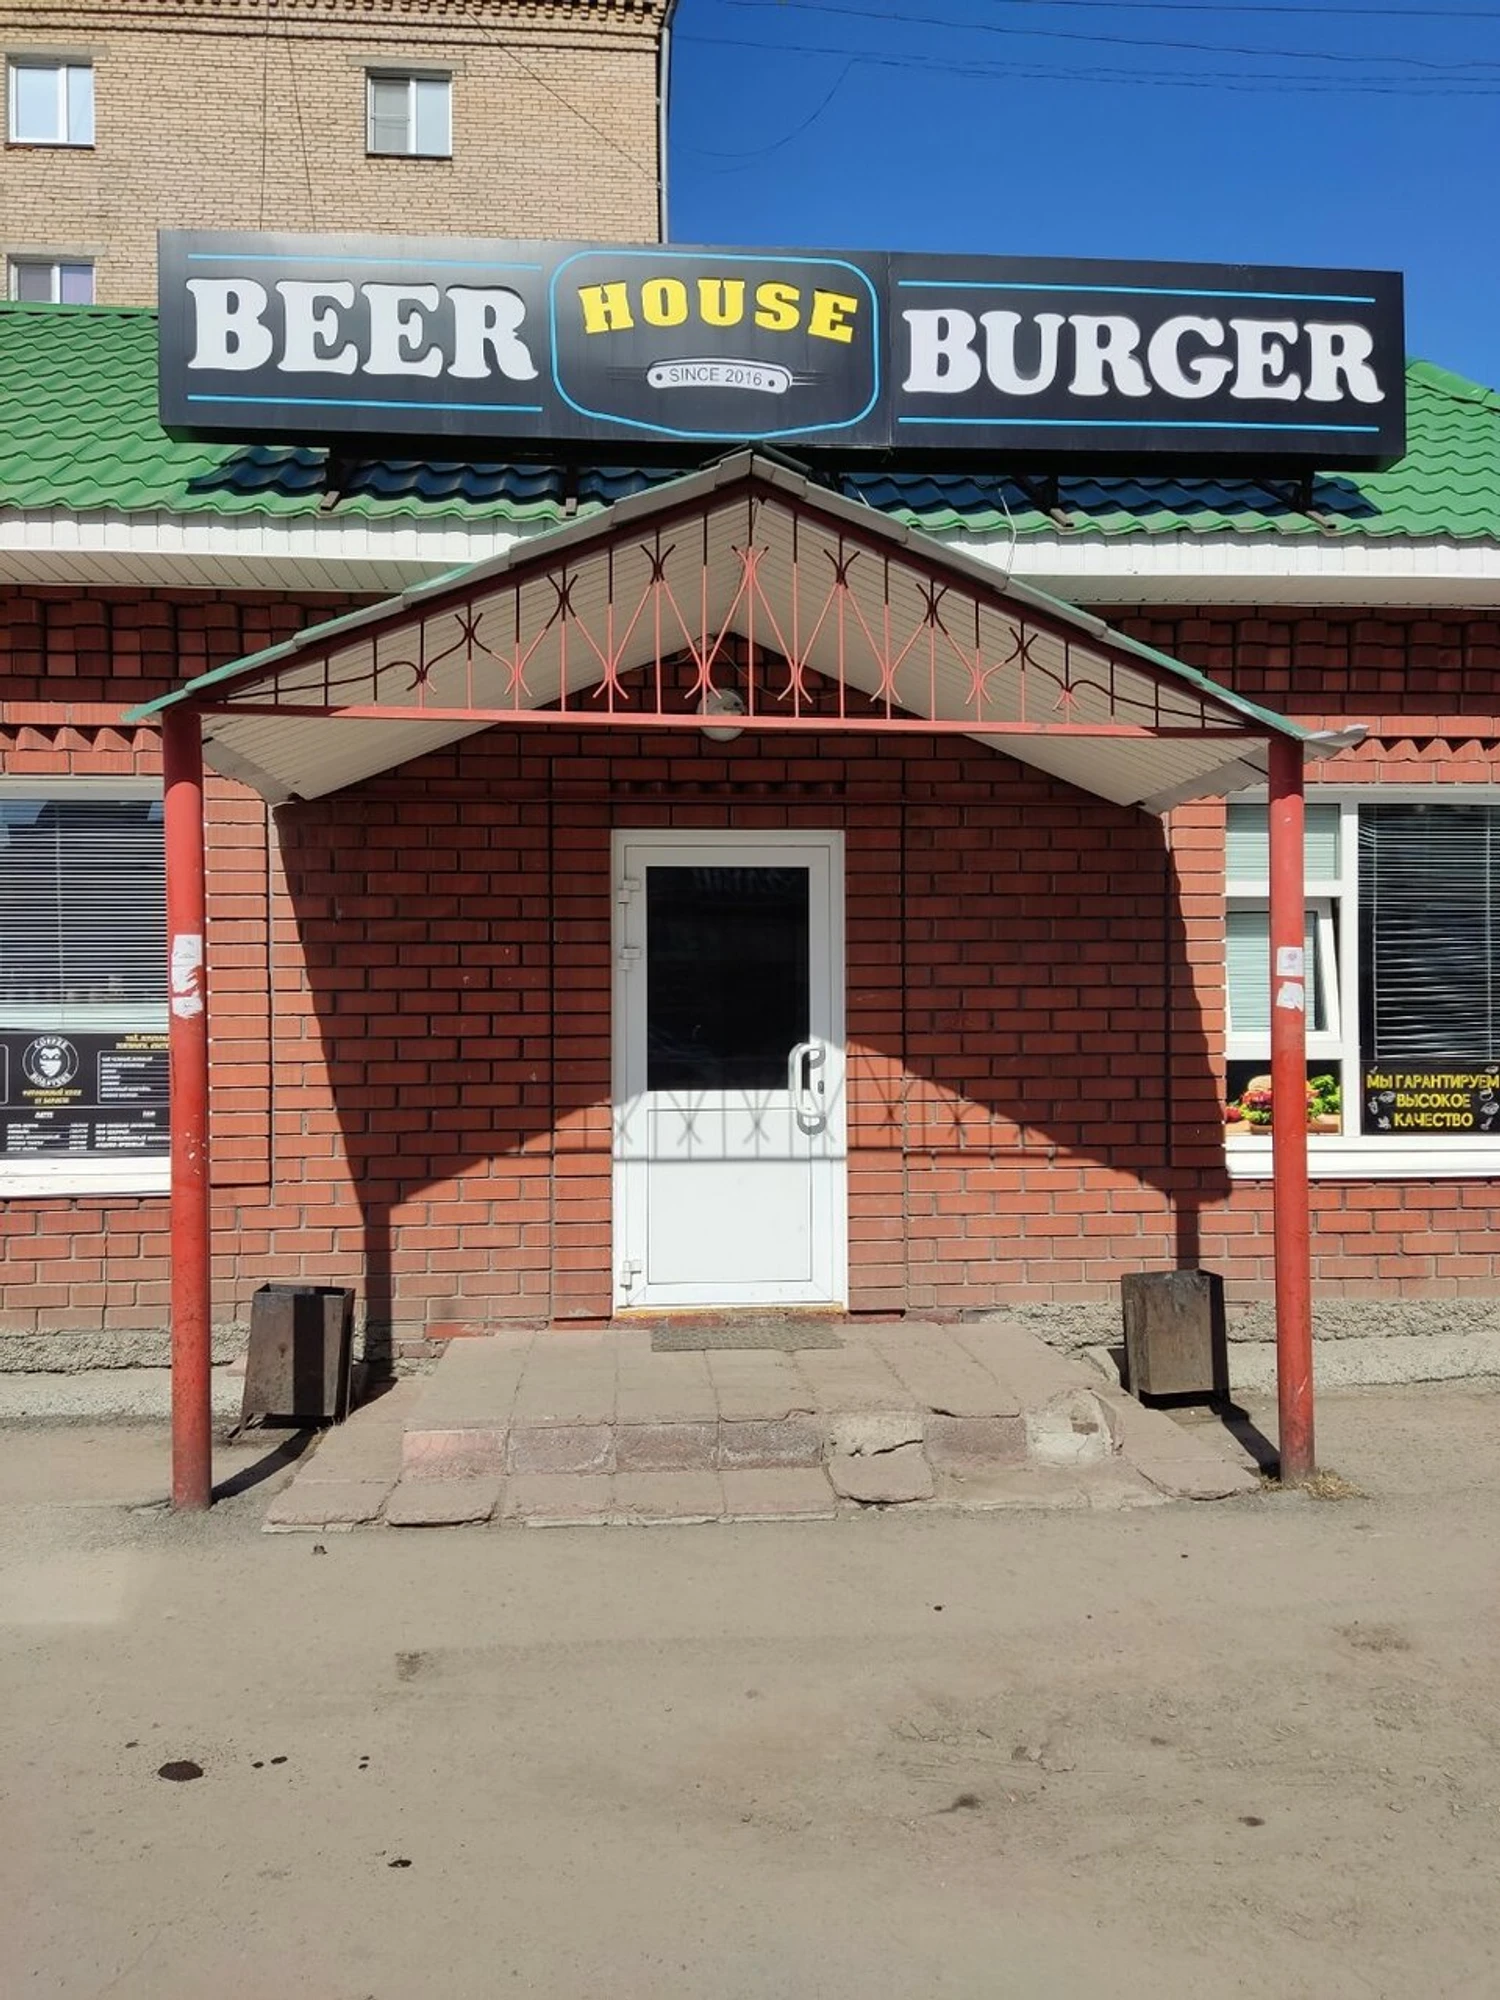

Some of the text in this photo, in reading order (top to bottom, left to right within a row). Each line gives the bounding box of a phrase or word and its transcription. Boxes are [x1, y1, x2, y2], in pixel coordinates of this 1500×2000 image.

[578, 277, 858, 343] HOUSE
[186, 278, 539, 381] BEER
[902, 309, 1386, 403] BURGER
[669, 367, 763, 386] SINCE 2016
[1366, 1074, 1500, 1089] МЫ ГАРАНТИРУЕМ
[1396, 1093, 1472, 1108] ВЫСОКОЕ
[1393, 1112, 1474, 1127] КАЧЕСТВО
